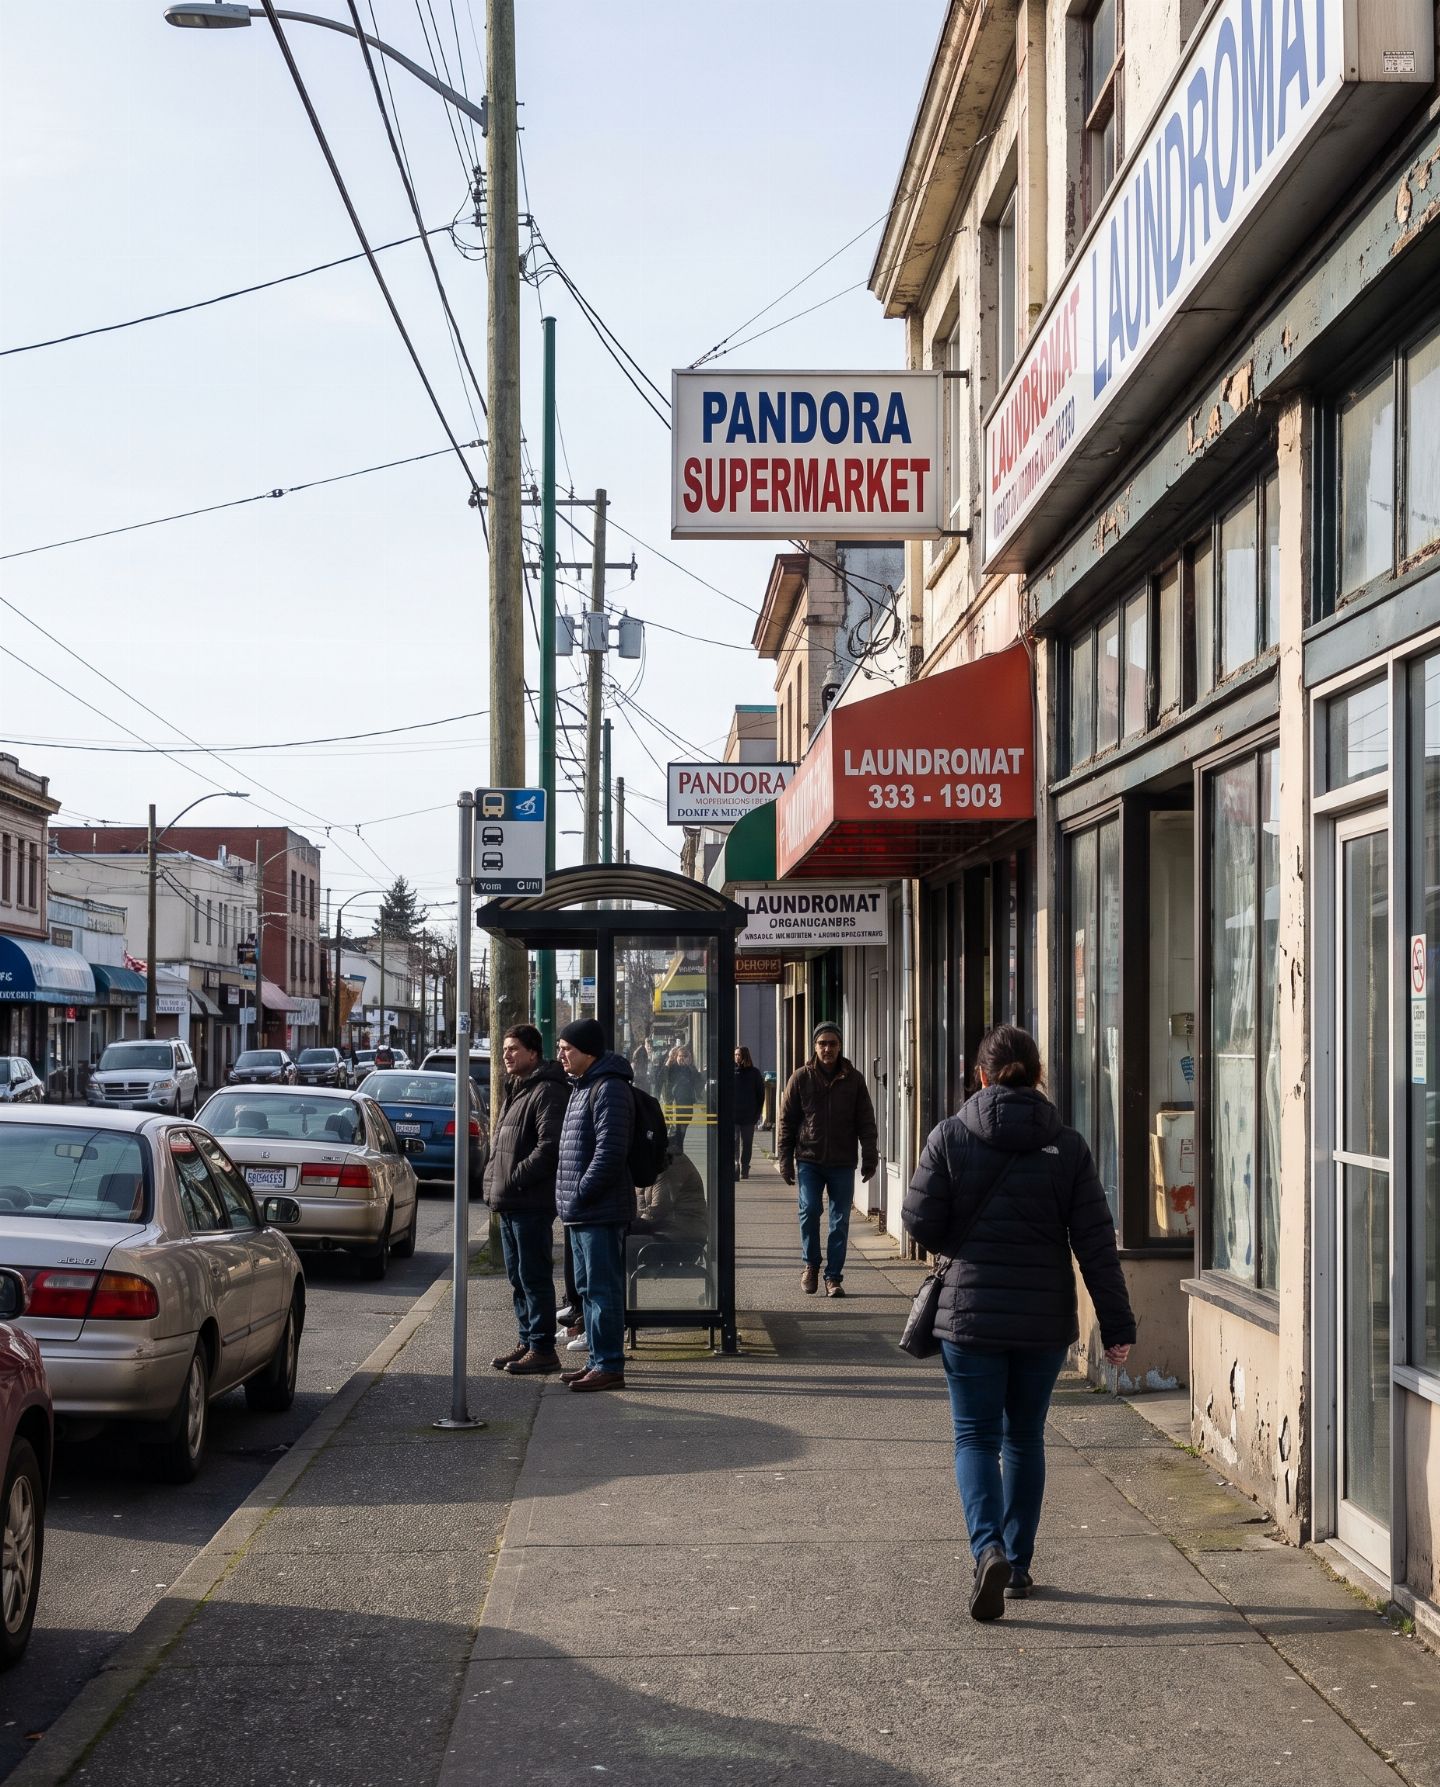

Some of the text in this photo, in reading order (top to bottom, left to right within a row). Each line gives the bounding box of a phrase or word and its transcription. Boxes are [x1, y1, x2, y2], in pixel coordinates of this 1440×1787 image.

[992, 283, 1080, 495] LAUNDROMAT
[703, 391, 912, 444] PANDORA
[683, 457, 930, 513] SUPERMARKET
[844, 748, 1025, 776] LAUNDROMAT
[678, 772, 787, 794] PANDORA
[868, 784, 916, 809] 333
[940, 783, 1002, 808] 1903
[745, 893, 881, 915] LAUNDROMAT
